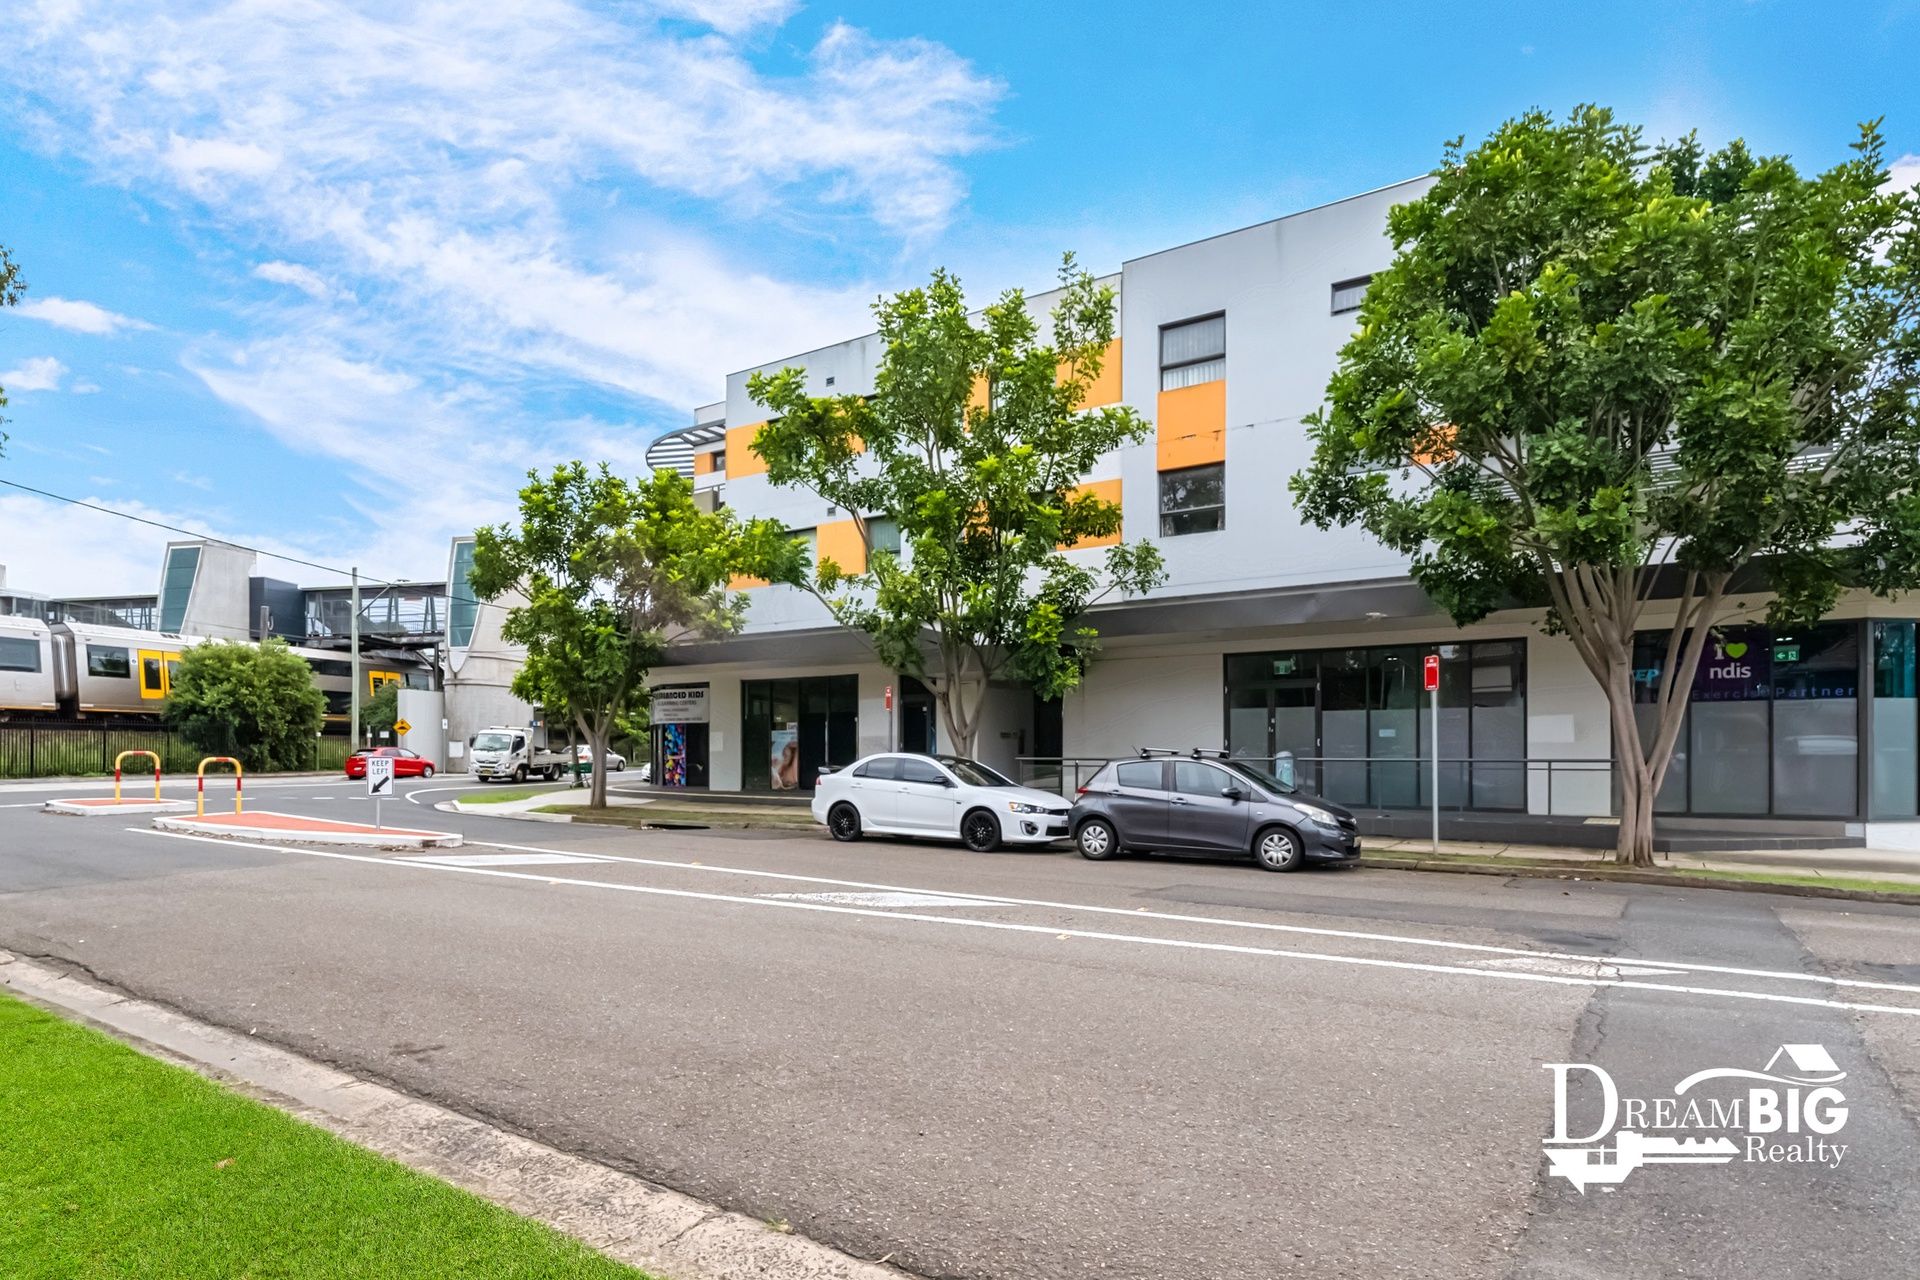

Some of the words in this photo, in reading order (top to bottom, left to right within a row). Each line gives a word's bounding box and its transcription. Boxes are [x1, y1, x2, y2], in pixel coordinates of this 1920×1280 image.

[1633, 669, 1660, 685] EP
[1709, 662, 1752, 680] ndis
[688, 691, 704, 699] KIDS
[1776, 687, 1855, 698] Partner
